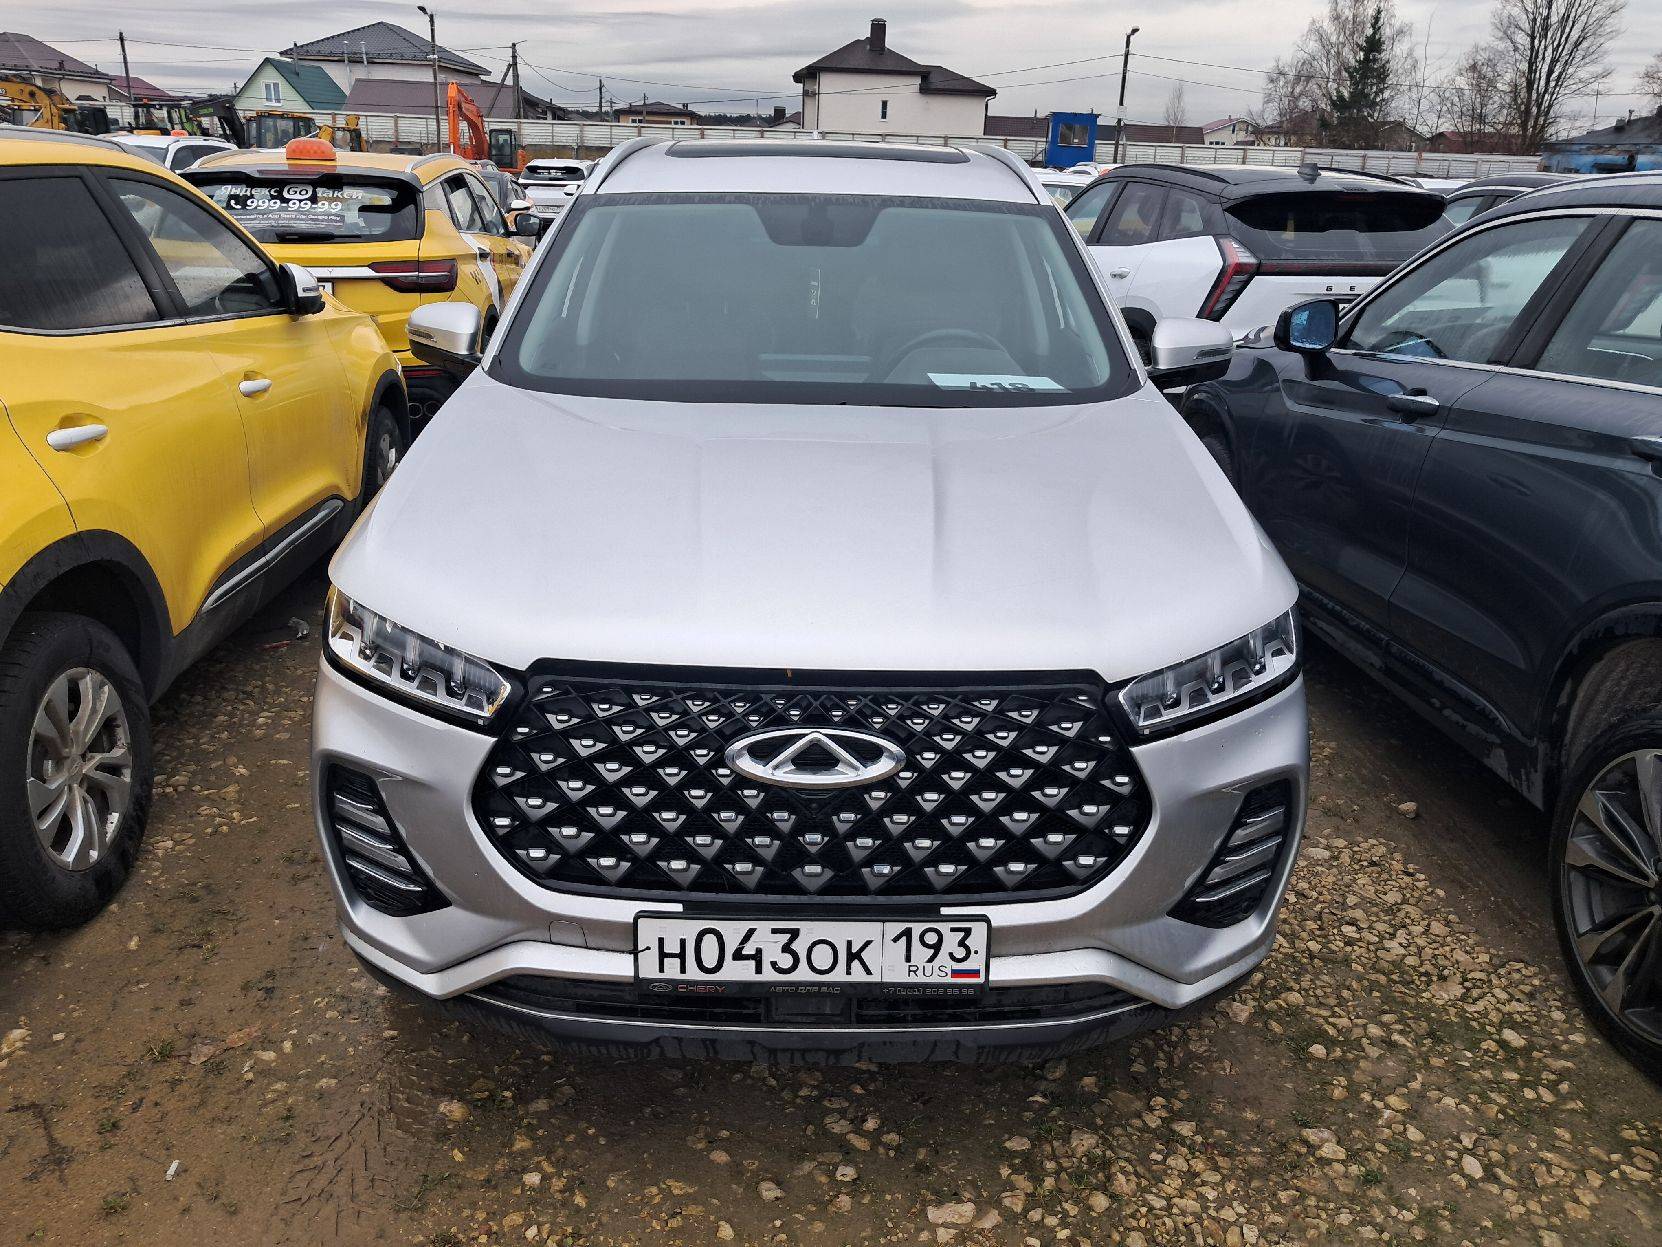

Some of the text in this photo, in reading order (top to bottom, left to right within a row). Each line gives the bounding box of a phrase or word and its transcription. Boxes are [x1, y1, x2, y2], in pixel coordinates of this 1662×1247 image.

[221, 185, 280, 196] Яндекс
[246, 198, 342, 212] 999-99-99
[657, 926, 973, 976] Н043ОК 193
[908, 965, 948, 978] RUS
[677, 984, 726, 993] CHERY
